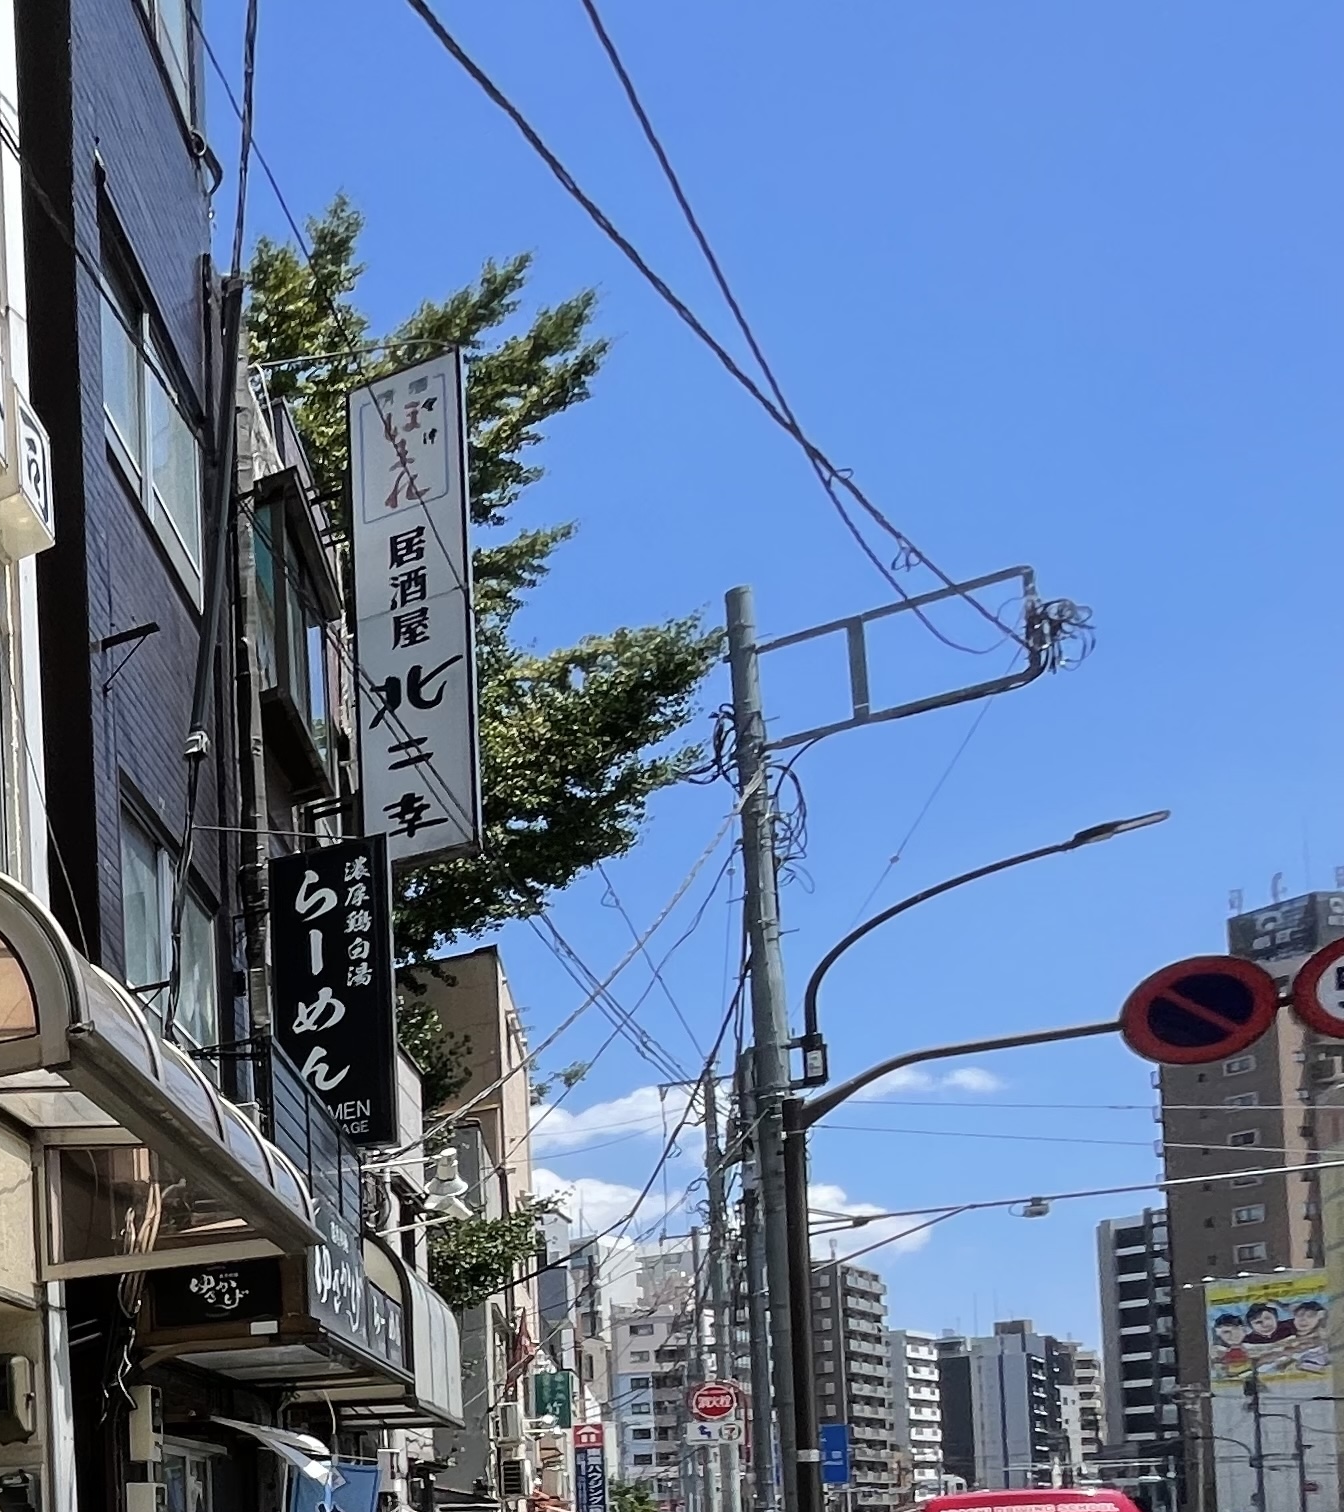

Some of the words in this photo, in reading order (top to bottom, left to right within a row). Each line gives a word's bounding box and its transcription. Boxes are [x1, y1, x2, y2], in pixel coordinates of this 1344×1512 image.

[292, 870, 350, 1090] らーめん
[327, 1099, 371, 1121] MEN
